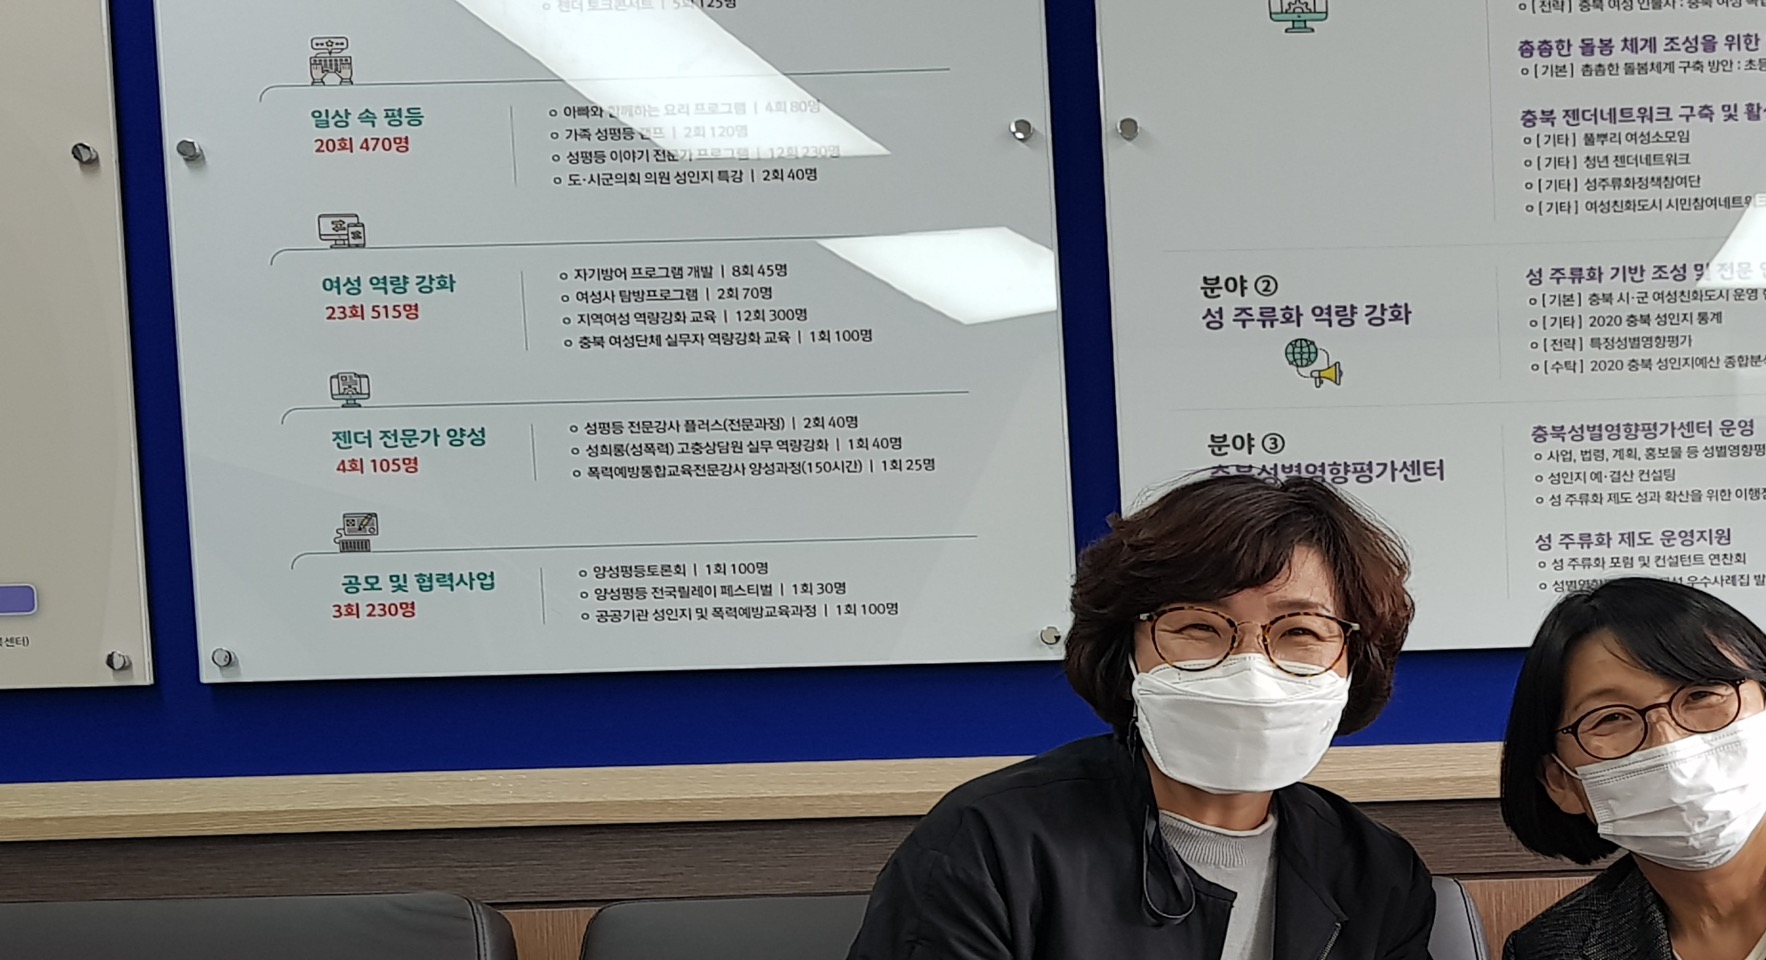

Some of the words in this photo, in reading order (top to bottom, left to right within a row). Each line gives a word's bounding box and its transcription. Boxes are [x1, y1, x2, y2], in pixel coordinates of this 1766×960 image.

[321, 275, 362, 296] 여성
[368, 274, 410, 296] 역량
[415, 273, 457, 295] 강화
[1200, 274, 1249, 300] 분야
[1201, 306, 1224, 331] 성
[1232, 304, 1304, 330] 주류화
[1310, 303, 1359, 328] 역량
[1364, 302, 1413, 328] 강화
[331, 429, 373, 450] 젠더
[378, 427, 441, 449] 전문가
[446, 426, 486, 448] 양성
[341, 574, 383, 595] 공모
[388, 573, 409, 594] 및
[413, 570, 495, 593] 협력사업
